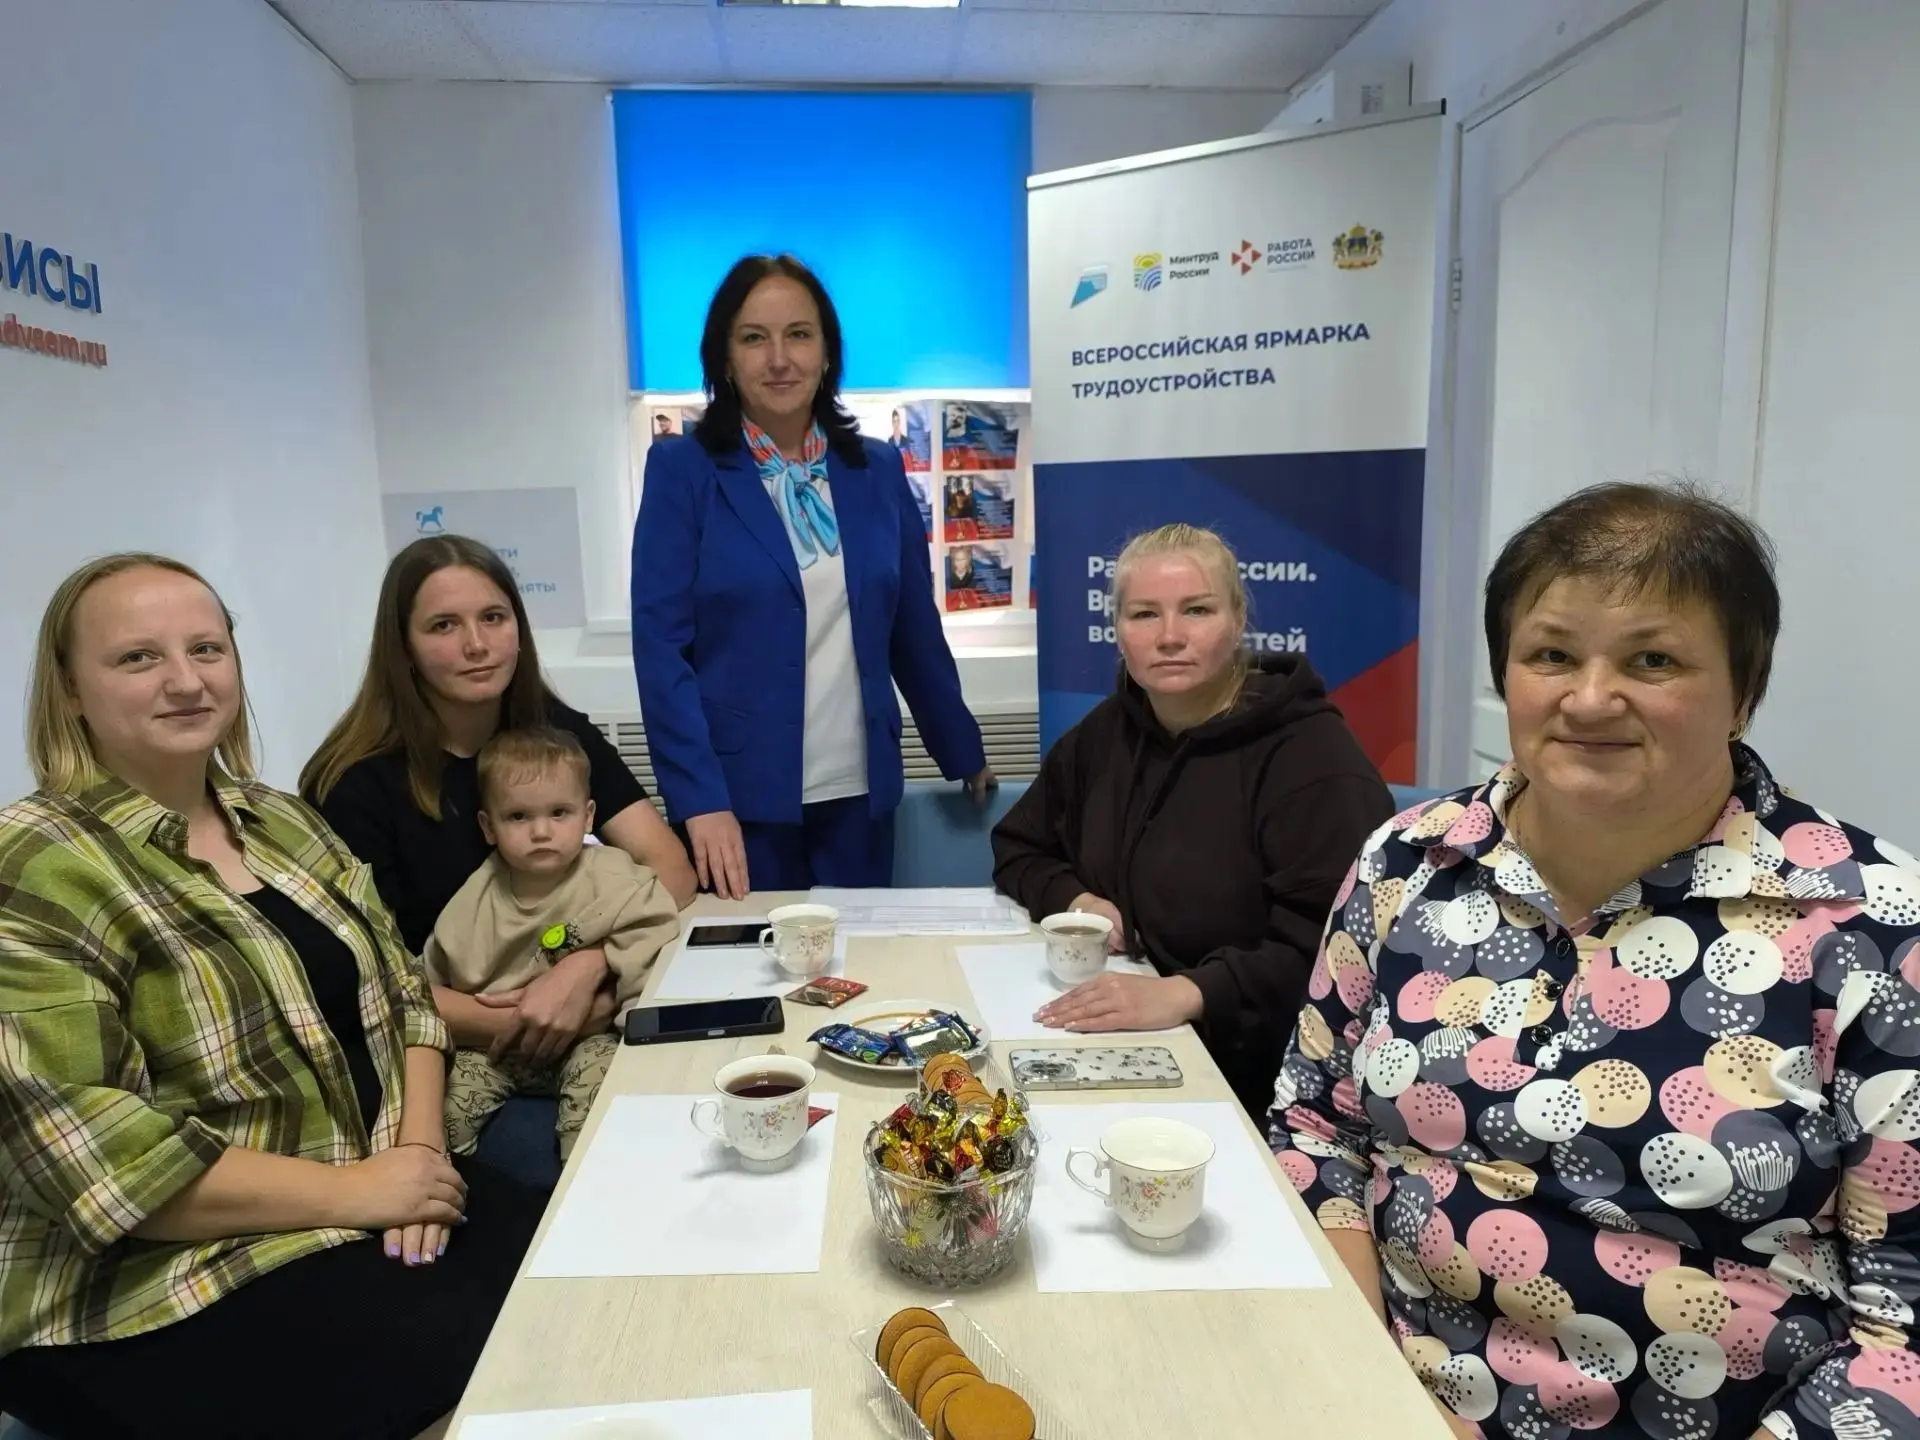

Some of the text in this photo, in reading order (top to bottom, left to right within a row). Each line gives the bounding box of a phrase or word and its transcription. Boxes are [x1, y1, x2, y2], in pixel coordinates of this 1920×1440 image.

[1267, 238, 1313, 253] РАБОТА
[1169, 251, 1219, 265] Минтруд
[1267, 250, 1316, 266] РОССИИ
[0, 232, 102, 313] ИСЫ
[1169, 267, 1210, 280] России
[0, 313, 107, 368] dvsem.ru
[1072, 322, 1370, 367] ВСЕРОССИЙСКАЯ ЯРМАРКА
[1072, 367, 1276, 399] ТРУДОУСТРОЙСТВА
